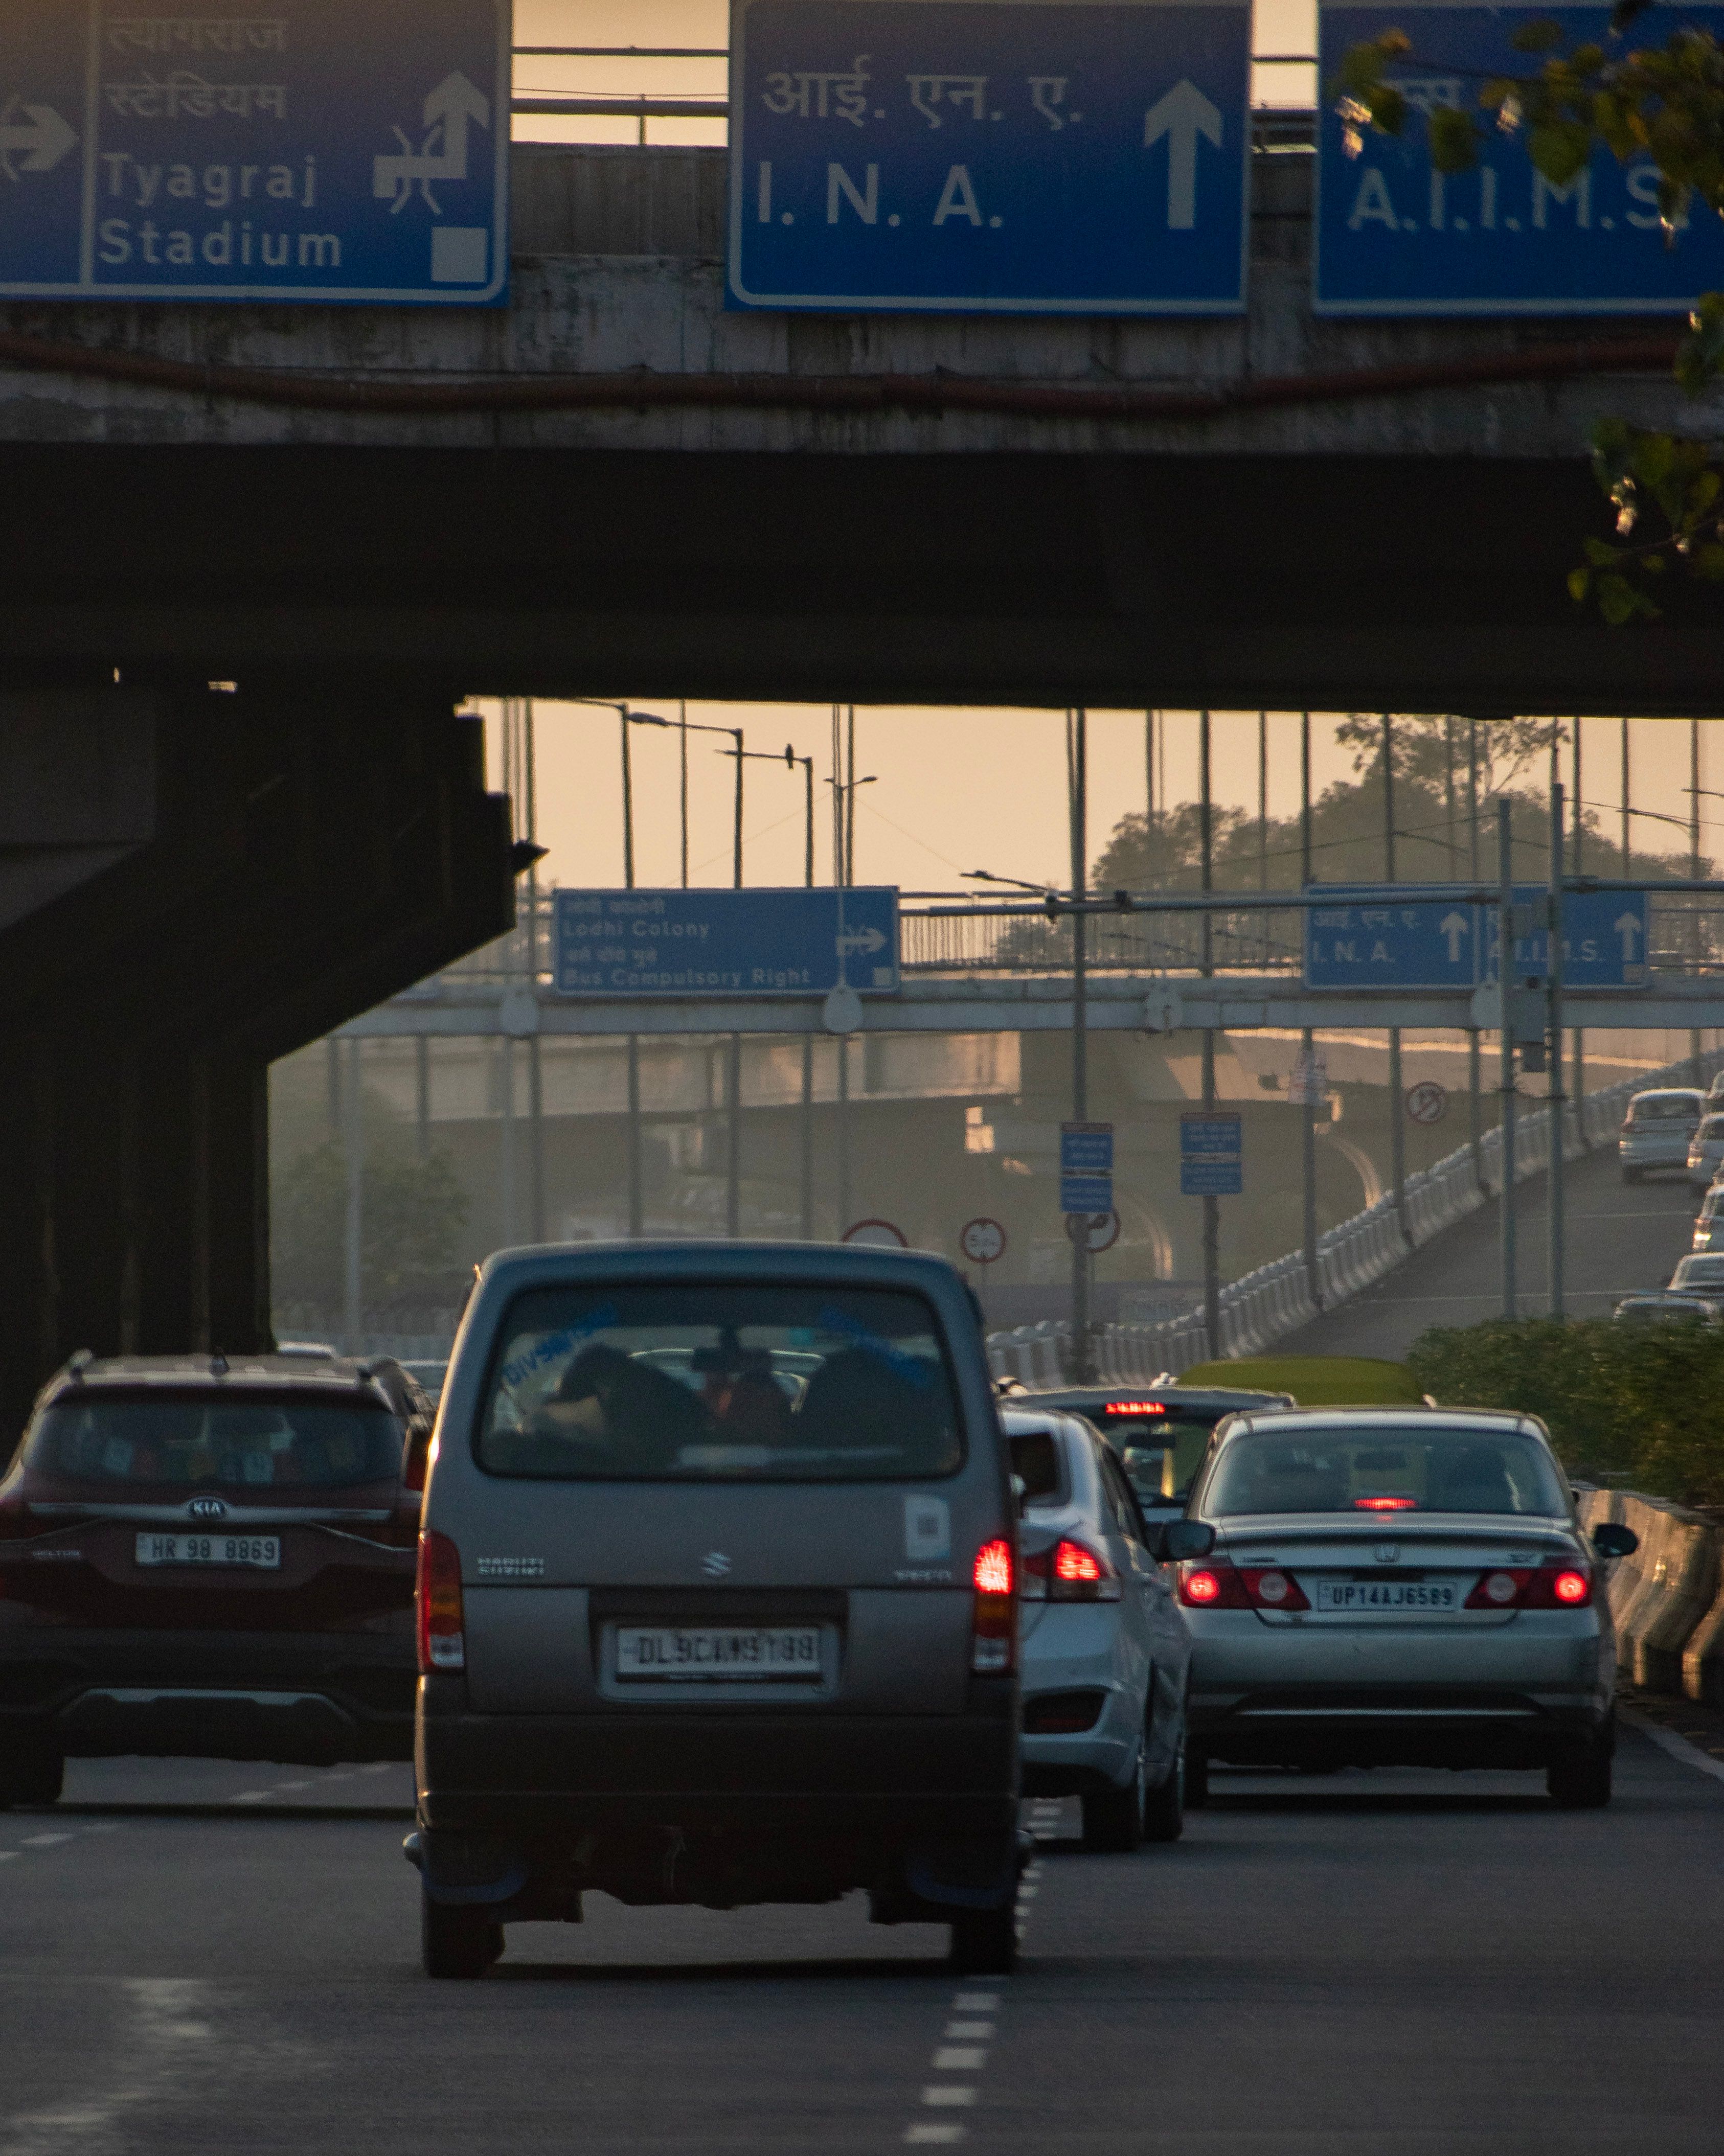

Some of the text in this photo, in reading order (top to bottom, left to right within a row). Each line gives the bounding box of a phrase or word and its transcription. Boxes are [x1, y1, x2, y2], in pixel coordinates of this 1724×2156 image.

[99, 152, 317, 209] Tyagraj
[99, 218, 342, 267] Stadium
[563, 920, 710, 943] Lodhi Colony
[563, 967, 811, 988] Bus Compulsory Right
[193, 1501, 220, 1512] KIA
[151, 1538, 176, 1558] HR
